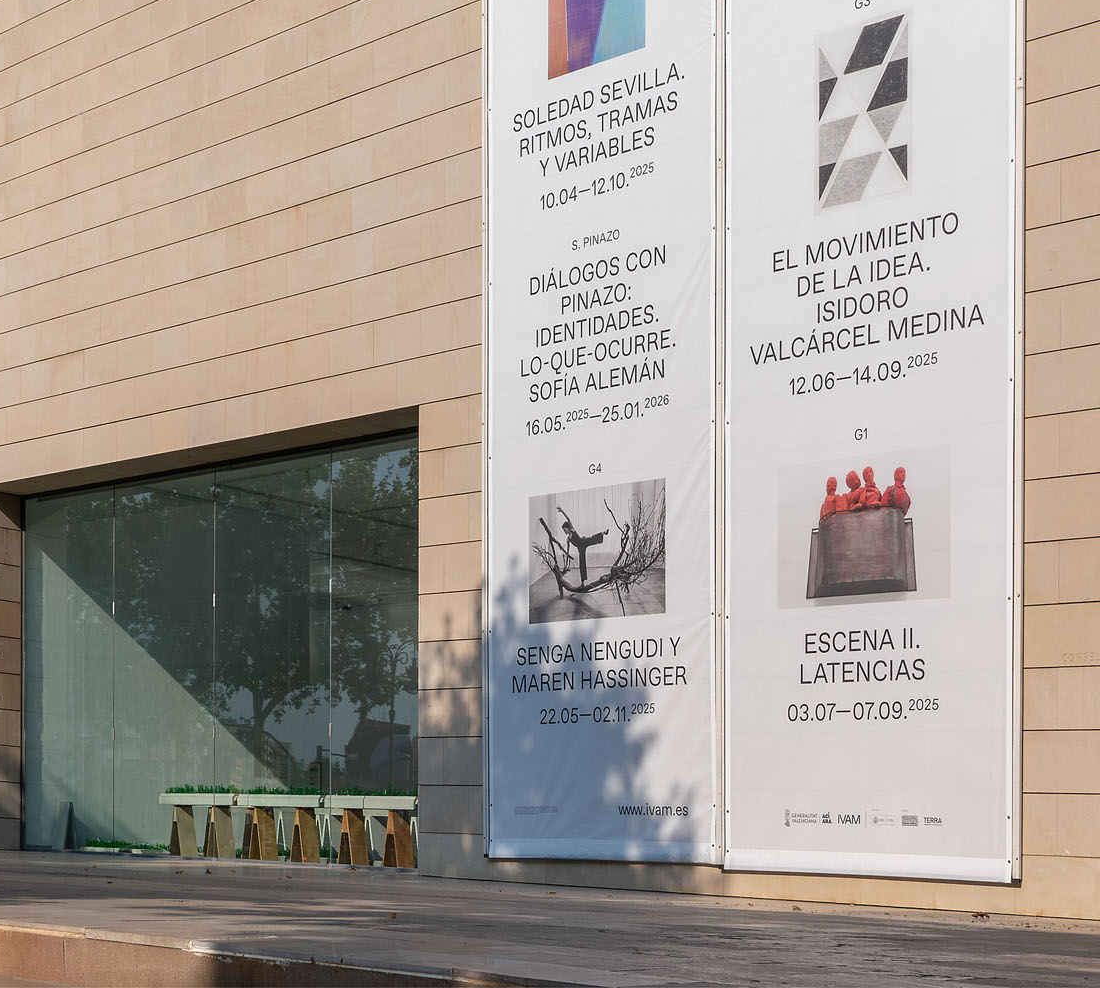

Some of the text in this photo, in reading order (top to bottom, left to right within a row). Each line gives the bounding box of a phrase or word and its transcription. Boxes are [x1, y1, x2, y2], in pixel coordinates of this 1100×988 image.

[512, 62, 685, 132] SOLEDAD SEVILLA.
[519, 91, 678, 157] RITMOS, TRAMAS
[539, 126, 655, 177] Y VARIABLES
[571, 229, 620, 251] S. PINAZO
[773, 212, 959, 273] EL MOVIMIENTO
[530, 245, 666, 296] DIÁLOGOS CON
[797, 251, 930, 298] DE LA IDEA.
[562, 282, 632, 315] PINAZO:
[817, 286, 909, 324] ISIDORO
[536, 304, 659, 347] IDENTIDADES.
[750, 304, 985, 365] VALCÁRCEL MEDINA
[520, 329, 676, 378] LO-QUE-OCURRE.
[529, 357, 665, 403] SOFÍA ALEMÁN
[854, 428, 868, 441] G1
[588, 463, 602, 474] G4
[517, 636, 681, 666] SENGA NENGUDI Y
[805, 627, 920, 654] ESCENA II.
[512, 665, 687, 694] MAREN HASSINGER
[800, 658, 926, 685] LATENCIAS
[618, 802, 689, 816] www.ivam.es
[837, 814, 861, 825] IVAM
